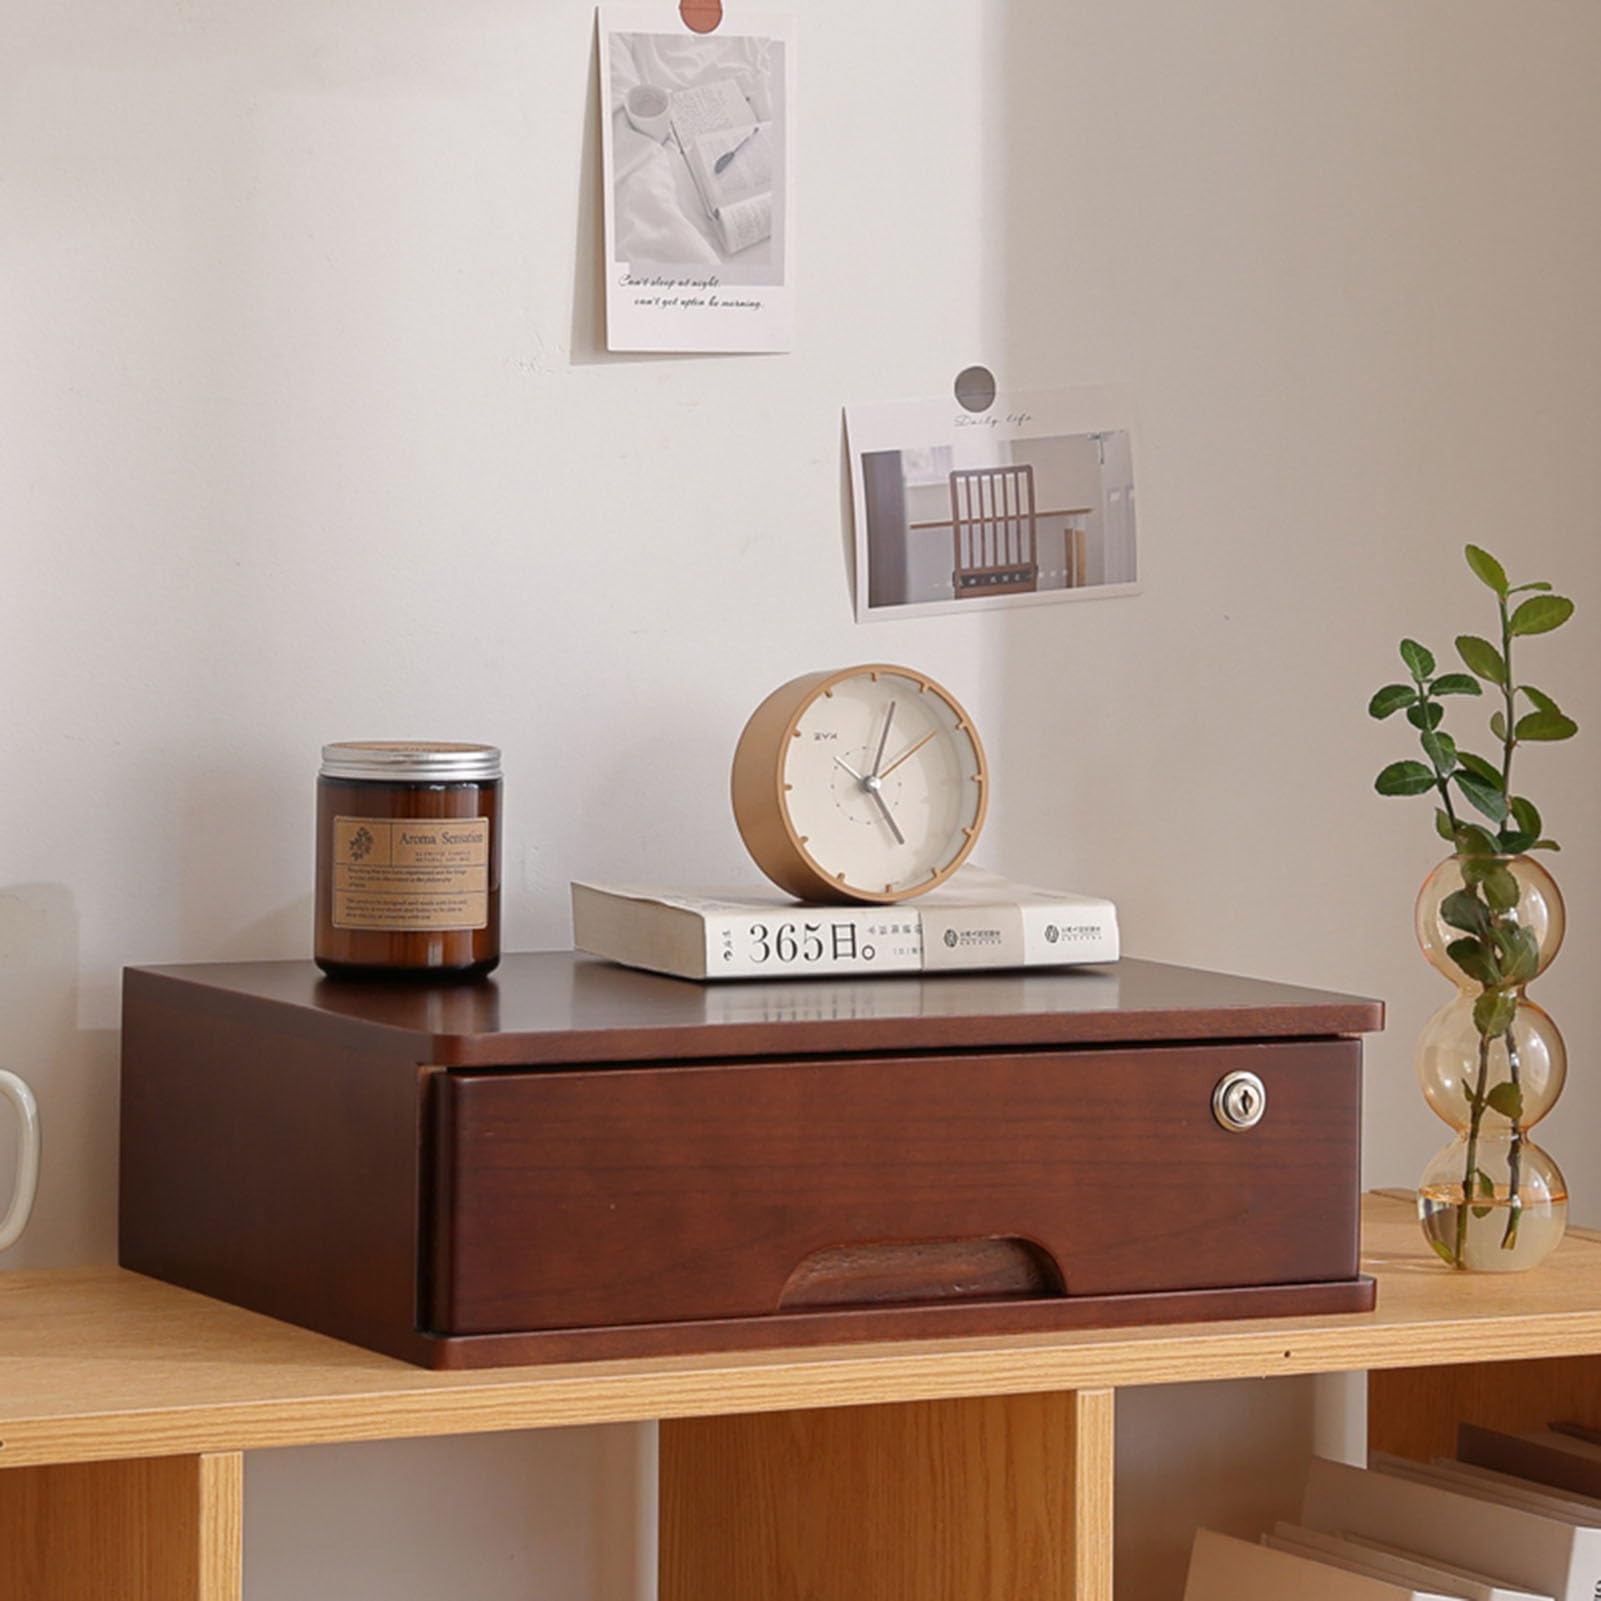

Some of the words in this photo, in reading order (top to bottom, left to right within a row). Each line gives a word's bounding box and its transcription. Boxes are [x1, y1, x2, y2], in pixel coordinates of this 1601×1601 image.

[618, 274, 649, 287] Can't
[651, 276, 676, 289] sleep
[678, 278, 690, 287] at
[634, 297, 661, 305] can't
[662, 297, 679, 309] get
[953, 415, 999, 428] Daily
[400, 832, 436, 845] Aroma
